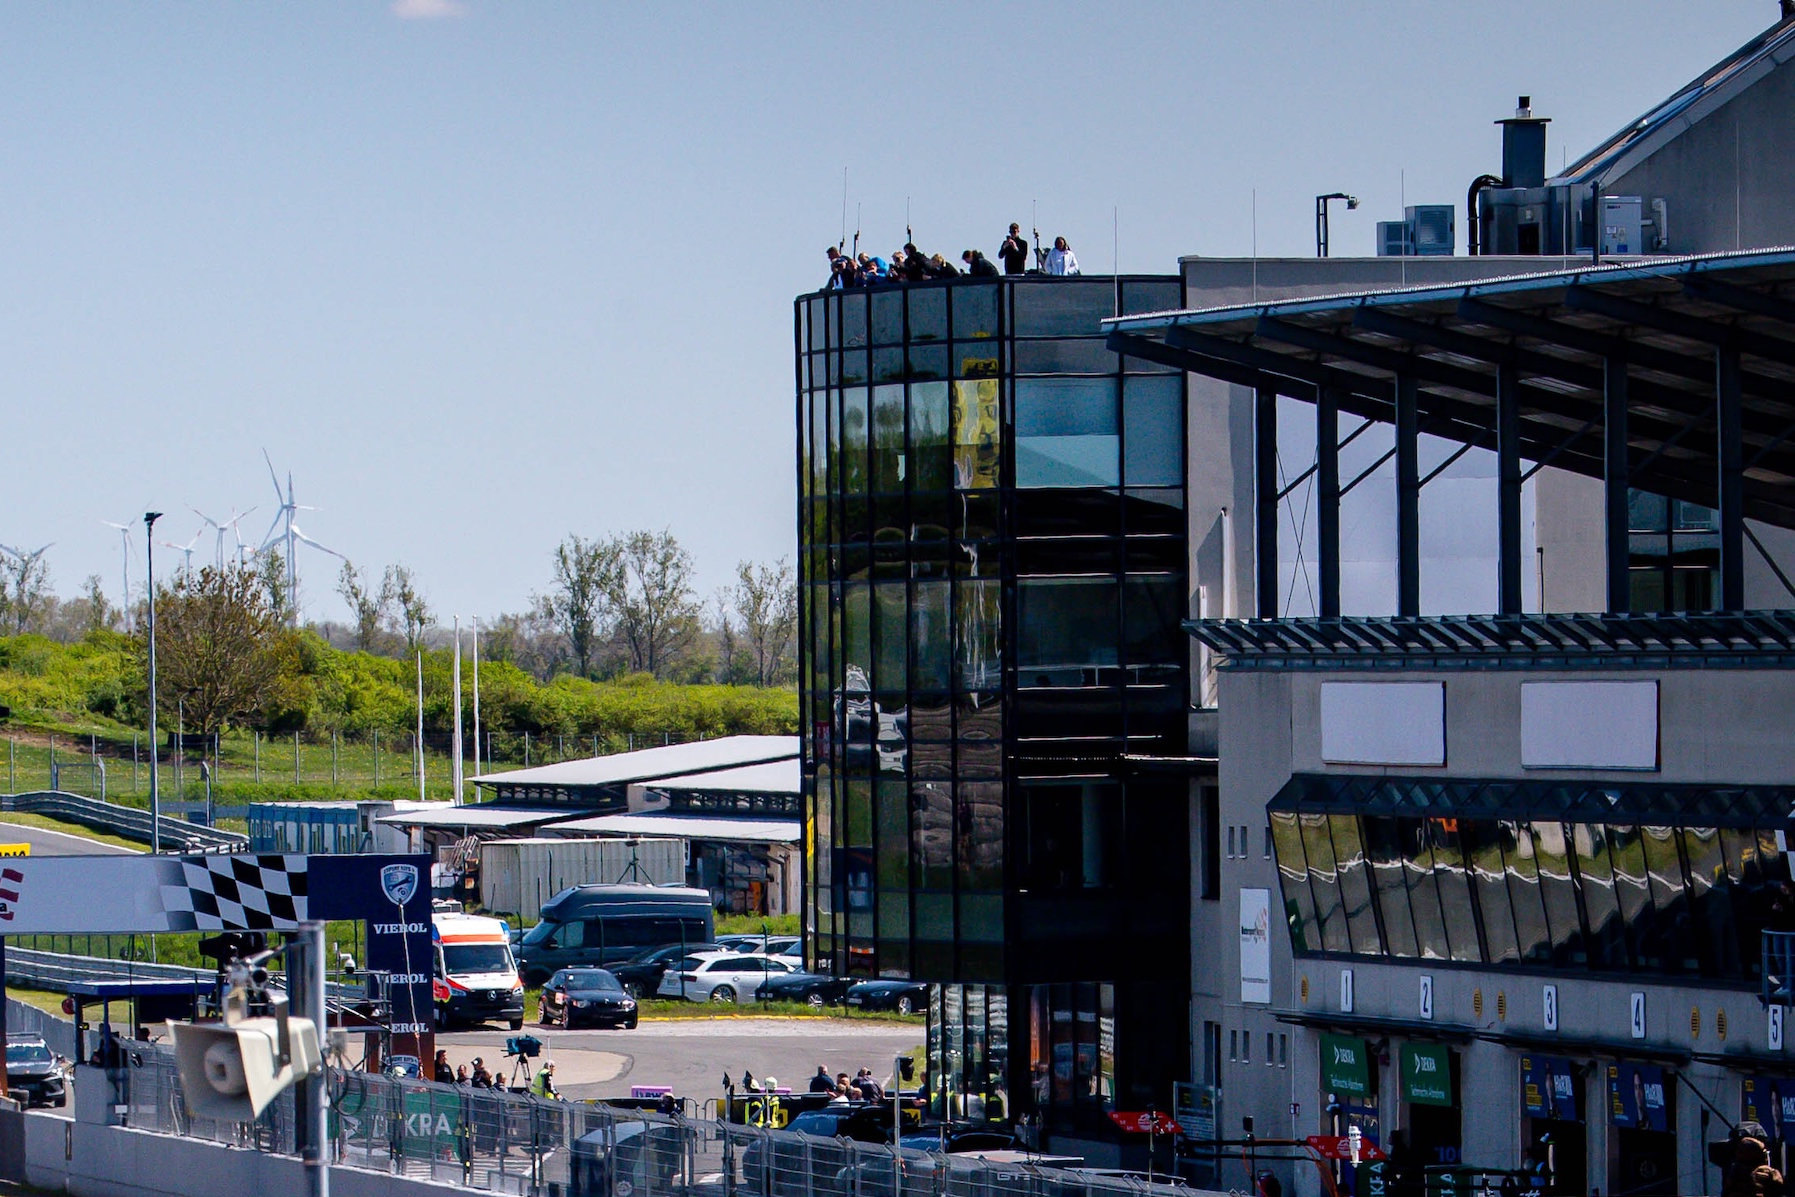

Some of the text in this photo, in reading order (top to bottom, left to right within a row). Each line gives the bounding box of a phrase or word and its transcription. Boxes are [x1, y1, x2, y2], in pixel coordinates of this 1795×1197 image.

[373, 922, 428, 935] VIEROL
[1342, 976, 1349, 1006] 1
[1421, 982, 1430, 1013] 2
[1546, 991, 1554, 1025] 3
[1634, 1000, 1642, 1032] 4
[1770, 1010, 1779, 1043] 5
